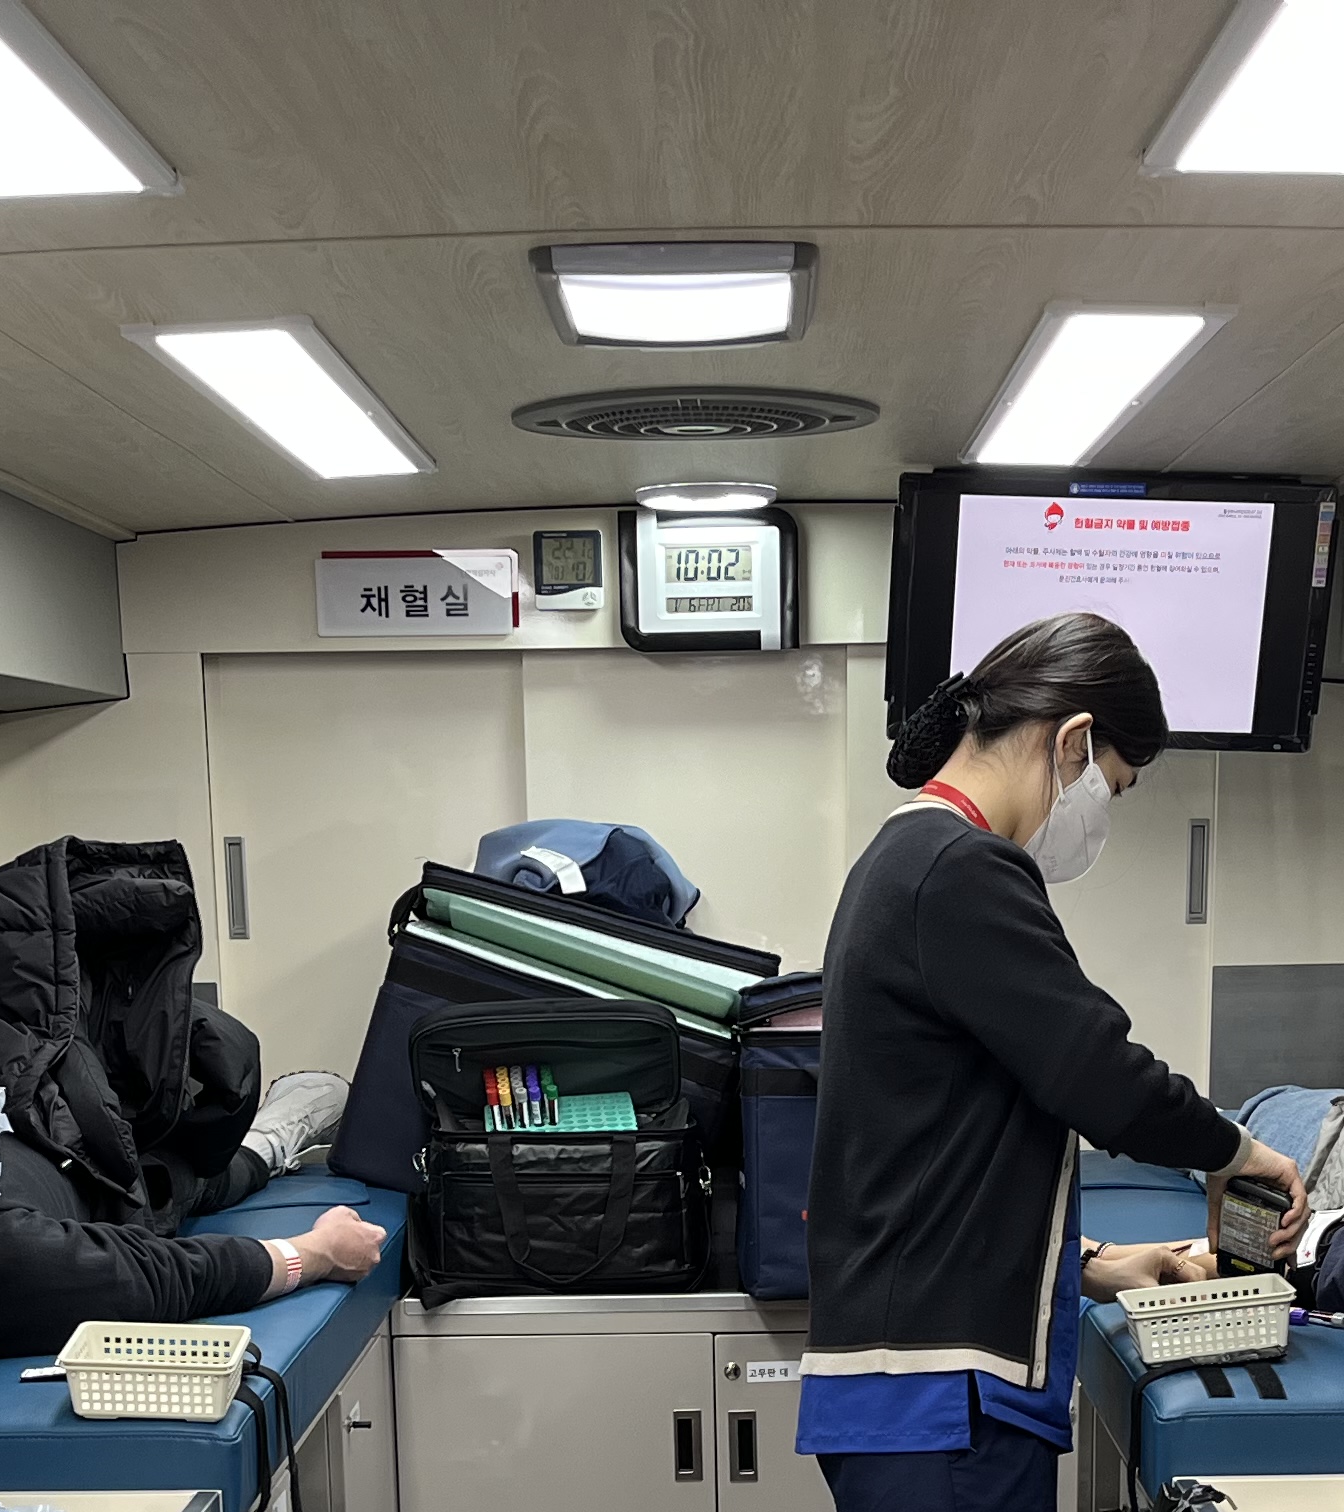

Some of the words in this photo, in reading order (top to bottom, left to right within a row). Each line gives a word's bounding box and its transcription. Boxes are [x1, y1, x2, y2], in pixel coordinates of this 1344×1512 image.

[1074, 517, 1113, 530] 헌혈금지
[675, 548, 740, 582] 10:02
[359, 583, 470, 618] 채혈실
